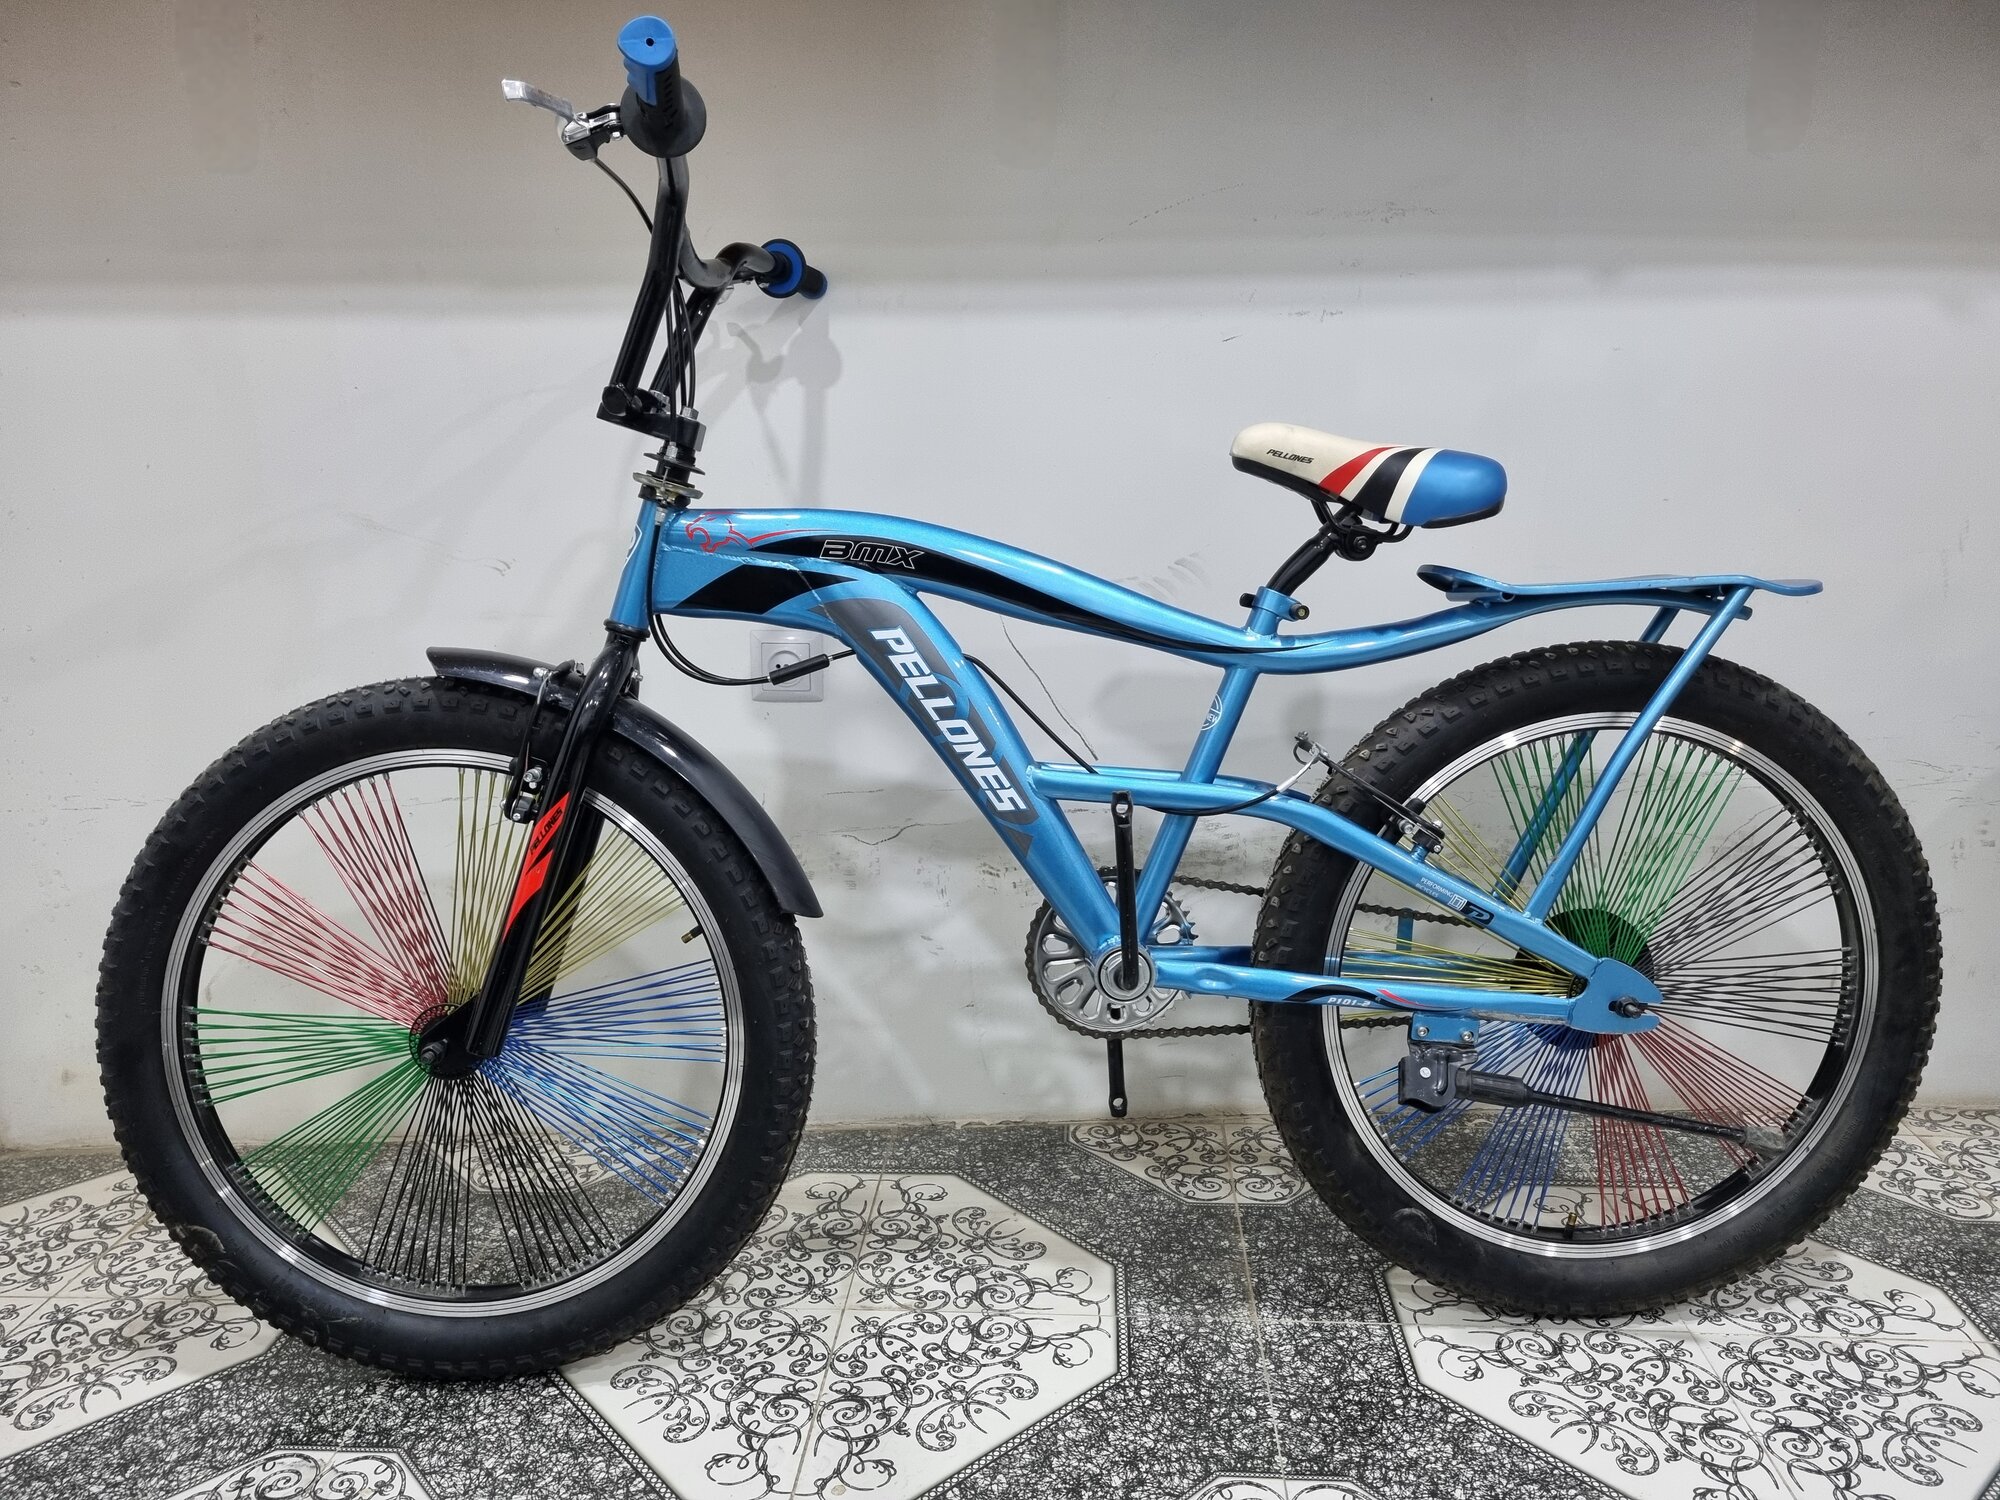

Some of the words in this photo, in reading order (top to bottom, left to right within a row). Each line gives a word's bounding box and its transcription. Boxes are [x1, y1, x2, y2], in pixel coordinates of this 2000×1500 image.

[1266, 448, 1314, 464] PELLONES
[819, 539, 925, 569] BMX
[869, 625, 1029, 813] PELLONES
[530, 806, 563, 855] PELLONES
[1420, 876, 1455, 898] PERFORMING
